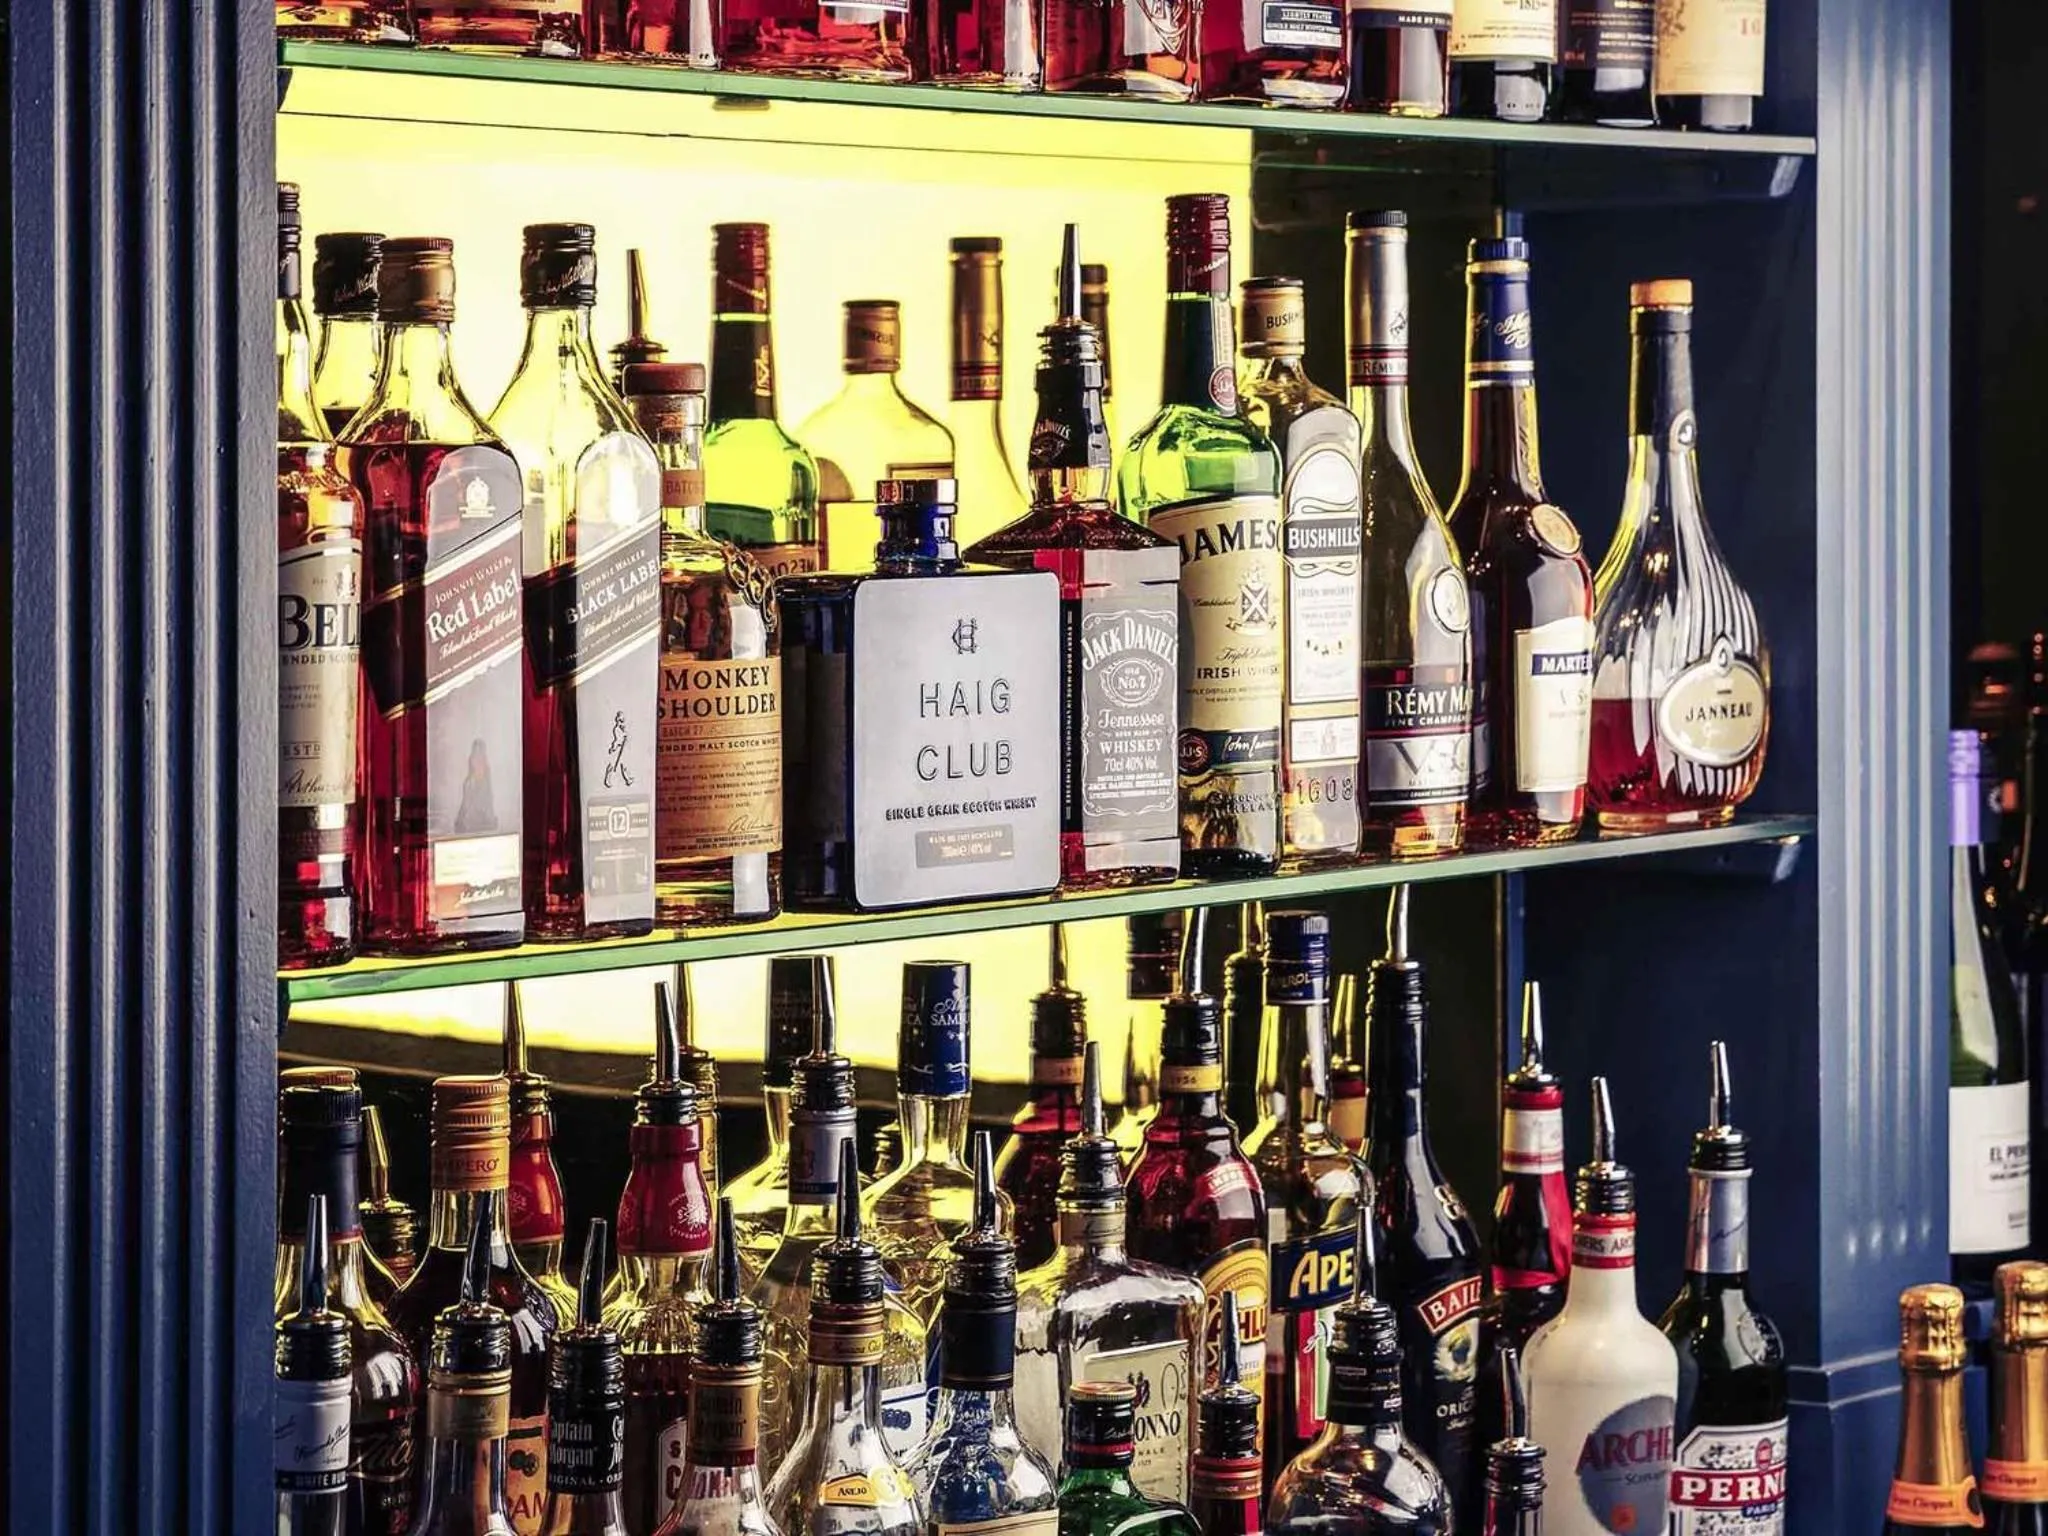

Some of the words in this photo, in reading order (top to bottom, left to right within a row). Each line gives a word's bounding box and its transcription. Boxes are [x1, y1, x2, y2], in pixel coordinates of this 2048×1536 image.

[1287, 526, 1361, 550] BUSHMILLS
[426, 598, 470, 644] Red
[469, 567, 524, 619] Label
[567, 583, 618, 624] BLACK
[1081, 626, 1123, 671] JACK
[664, 665, 770, 692] MONKEY
[1197, 667, 1241, 680] IRISH
[657, 692, 777, 719] SHOULDER
[919, 677, 1011, 719] HAIG
[1387, 687, 1448, 716] RÉMY
[1097, 708, 1166, 729] Tennessee
[1685, 702, 1754, 722] JANNEAU
[699, 742, 725, 751] MALT
[1100, 738, 1163, 755] WHISKEY
[916, 739, 1014, 782] CLUB
[613, 812, 627, 832] 12
[885, 805, 925, 822] SINGLE
[927, 802, 960, 819] GRAIN
[962, 799, 1002, 815] SCOTCH
[1288, 1247, 1355, 1299] APE
